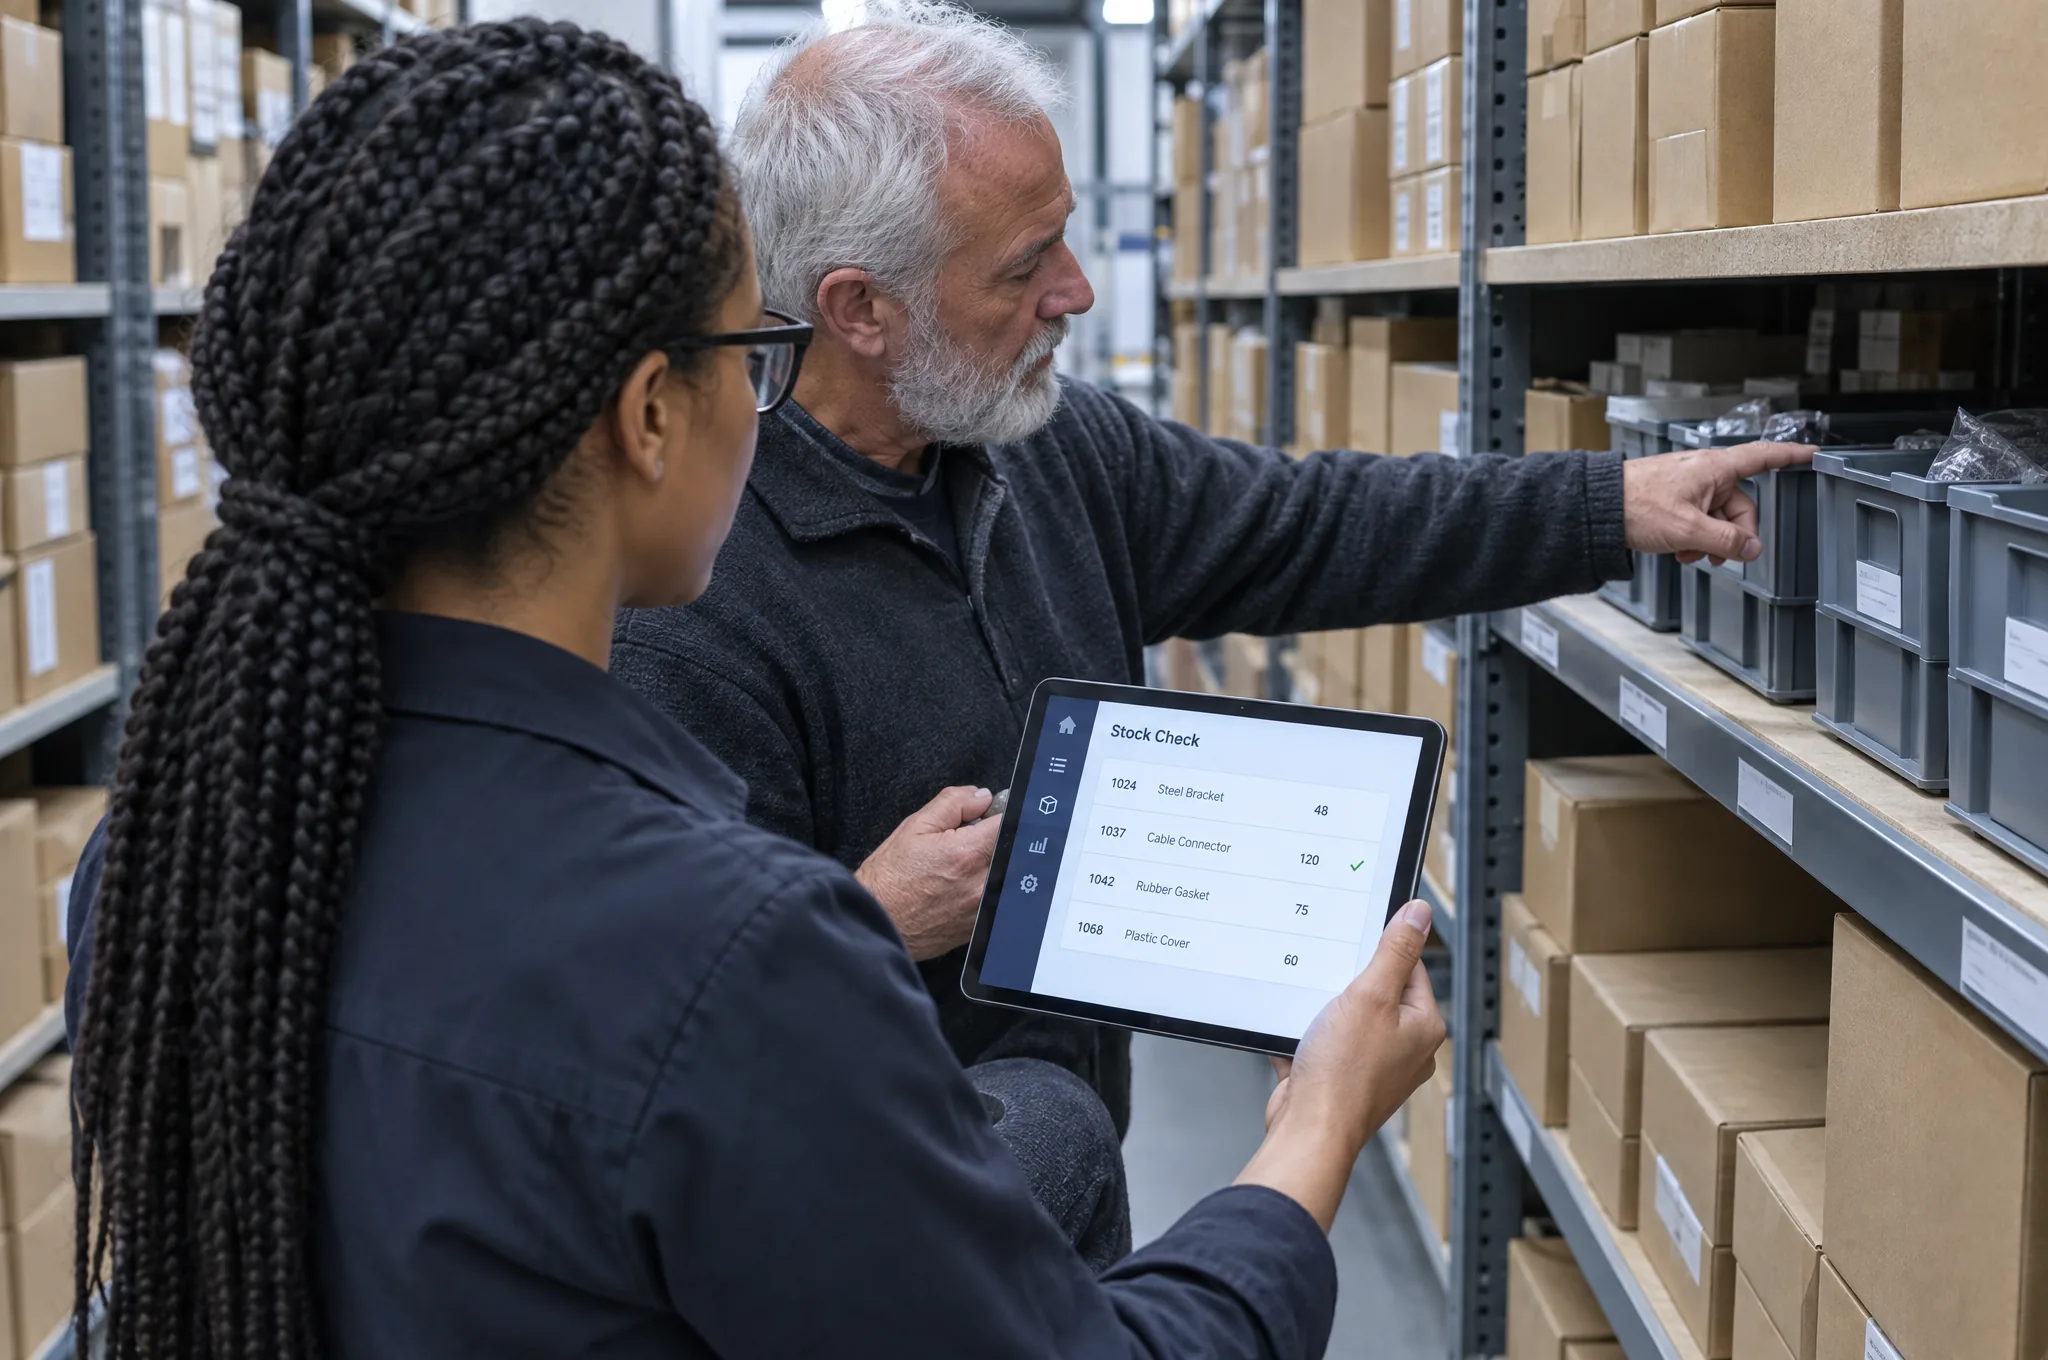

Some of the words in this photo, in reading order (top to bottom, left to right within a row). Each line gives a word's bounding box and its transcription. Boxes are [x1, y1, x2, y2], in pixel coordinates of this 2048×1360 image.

[1110, 724, 1152, 743] Stock
[1154, 729, 1201, 748] Check
[1111, 777, 1137, 791] 1024
[1157, 783, 1184, 797] Steel
[1185, 787, 1225, 803] Bracket
[1313, 804, 1329, 817] 48
[1100, 825, 1127, 839] 1037
[1147, 831, 1176, 846] Cable
[1177, 836, 1232, 853] Connector
[1299, 853, 1320, 866] 120
[1088, 873, 1115, 887] 1042
[1135, 880, 1173, 895] Rubber
[1174, 885, 1210, 901] Gasket
[1294, 903, 1309, 916] 75
[1077, 921, 1104, 936] 1068
[1124, 928, 1158, 945] Plastic
[1159, 934, 1191, 949] Cover
[1283, 953, 1299, 967] 60
